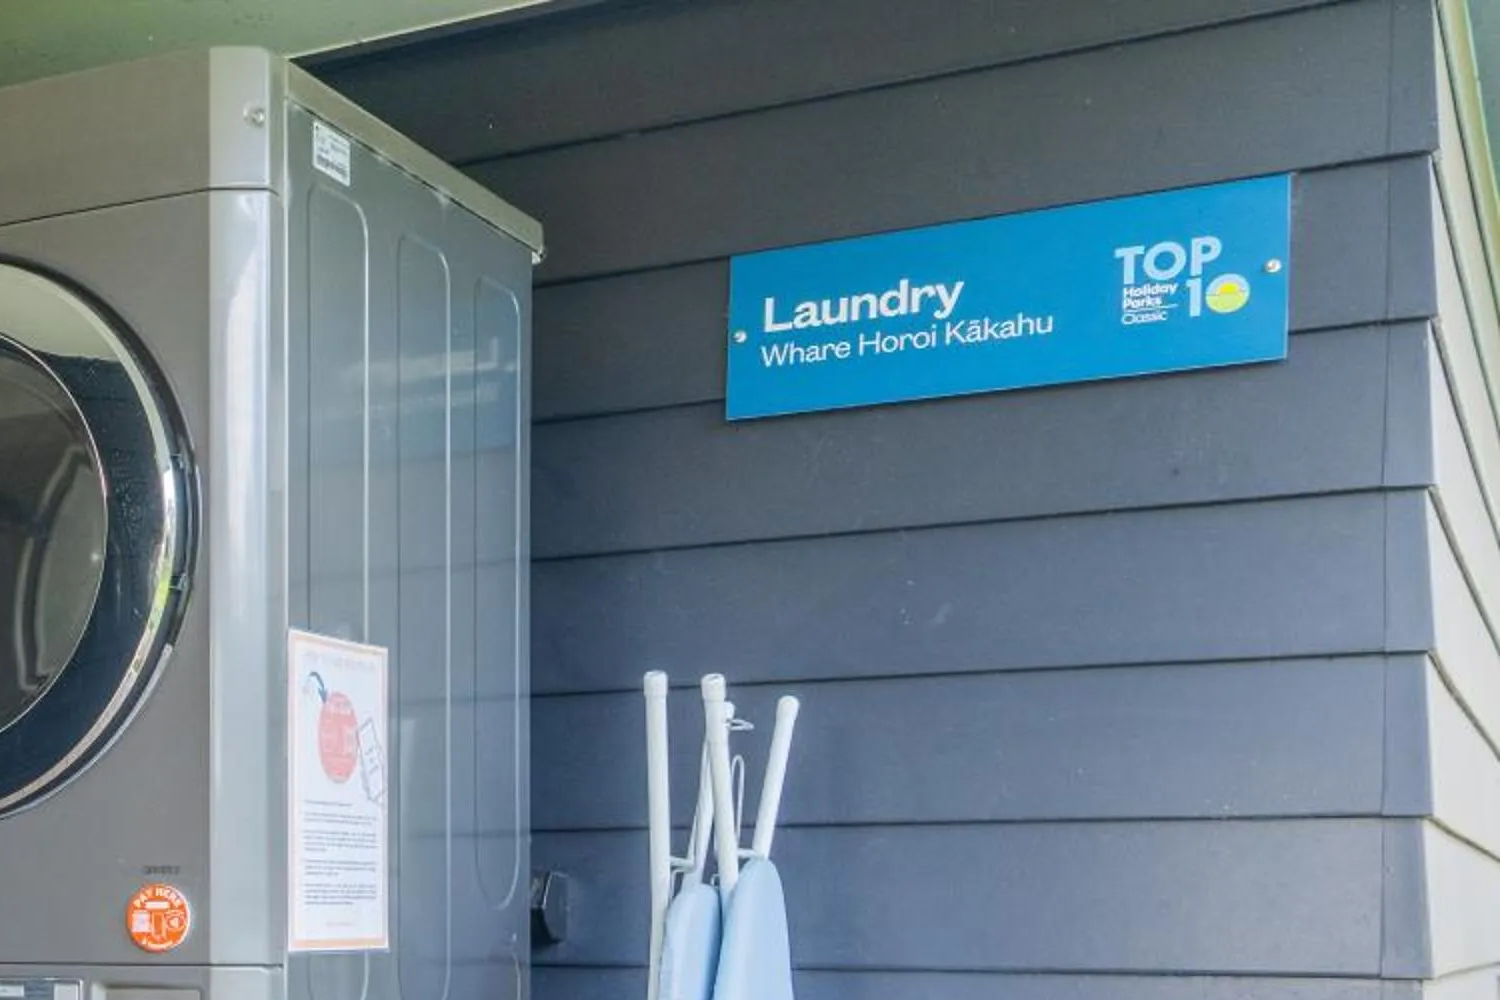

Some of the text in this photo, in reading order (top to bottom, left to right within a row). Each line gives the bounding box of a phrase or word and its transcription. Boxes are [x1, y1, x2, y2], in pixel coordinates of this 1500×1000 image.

[1114, 236, 1222, 285] TOP
[763, 278, 964, 333] Laundry
[1124, 283, 1179, 298] Holiday
[1124, 296, 1162, 310] Parks
[1186, 273, 1250, 317] 10
[1121, 311, 1168, 325] Classic
[761, 313, 1053, 368] Whare Horoi Kākahu
